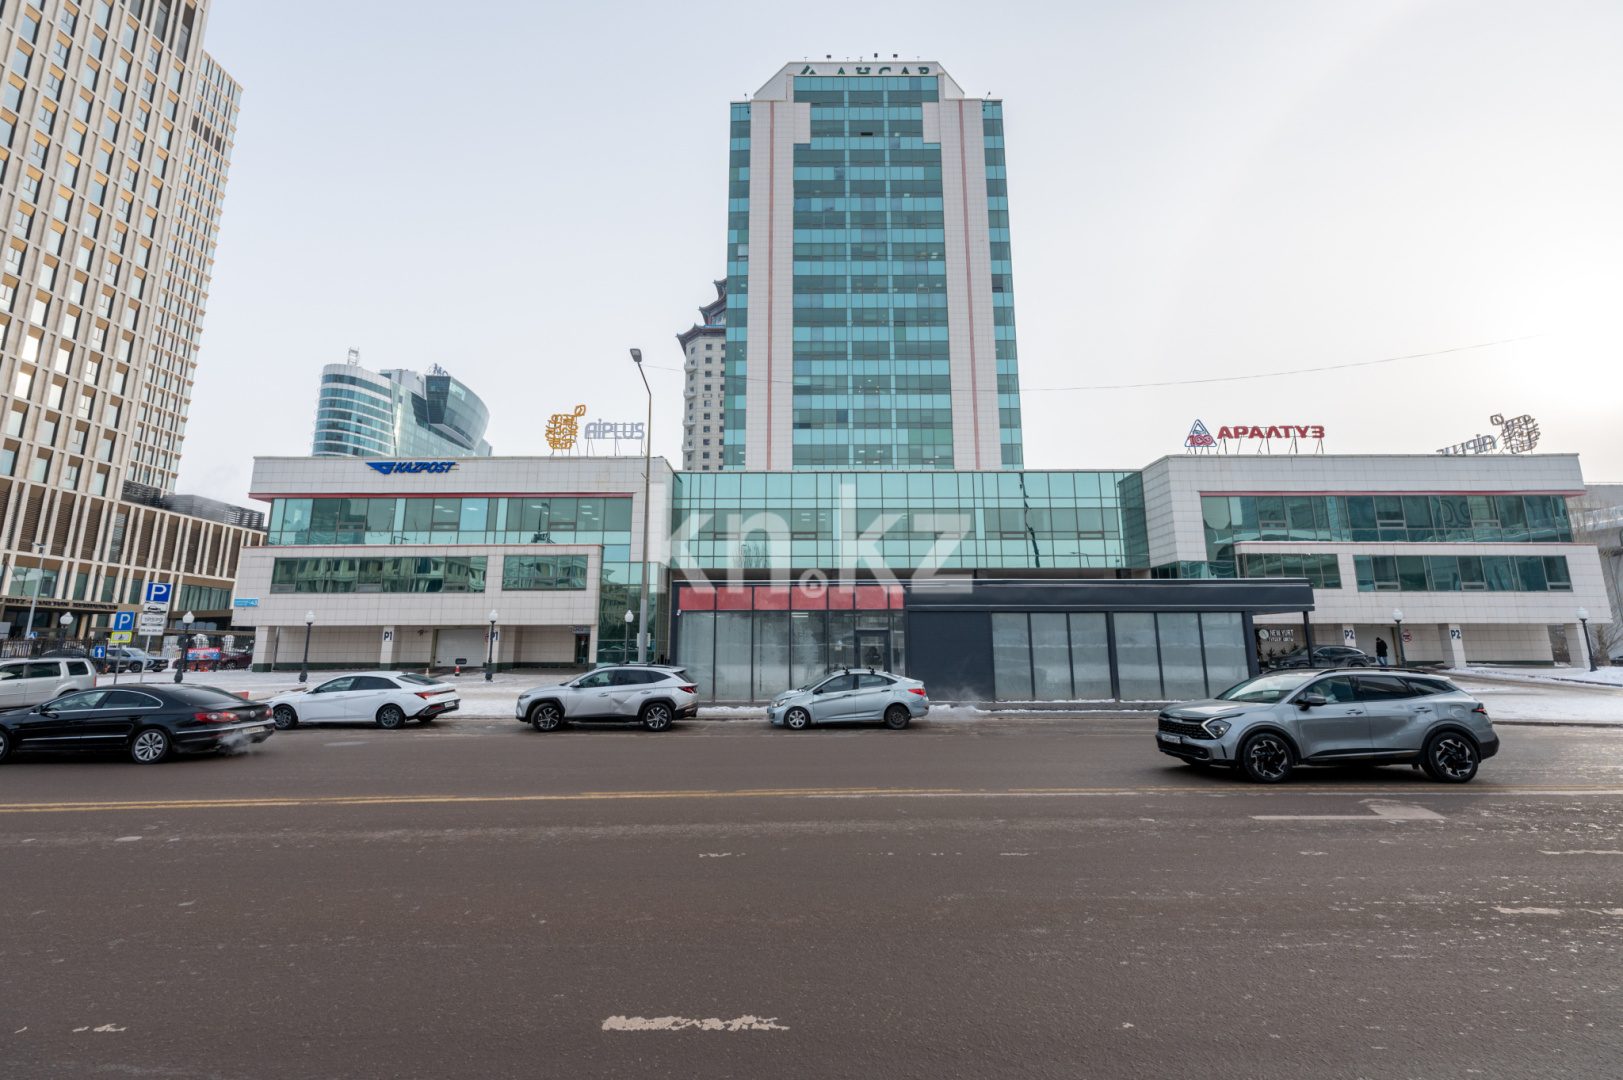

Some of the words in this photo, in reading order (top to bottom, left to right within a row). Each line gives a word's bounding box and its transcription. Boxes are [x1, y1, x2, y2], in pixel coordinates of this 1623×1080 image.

[393, 461, 456, 474] KAZPOST
[150, 584, 167, 601] P
[119, 613, 131, 629] P
[383, 631, 393, 641] P1
[1344, 629, 1354, 639] P2
[1450, 629, 1461, 639] P2
